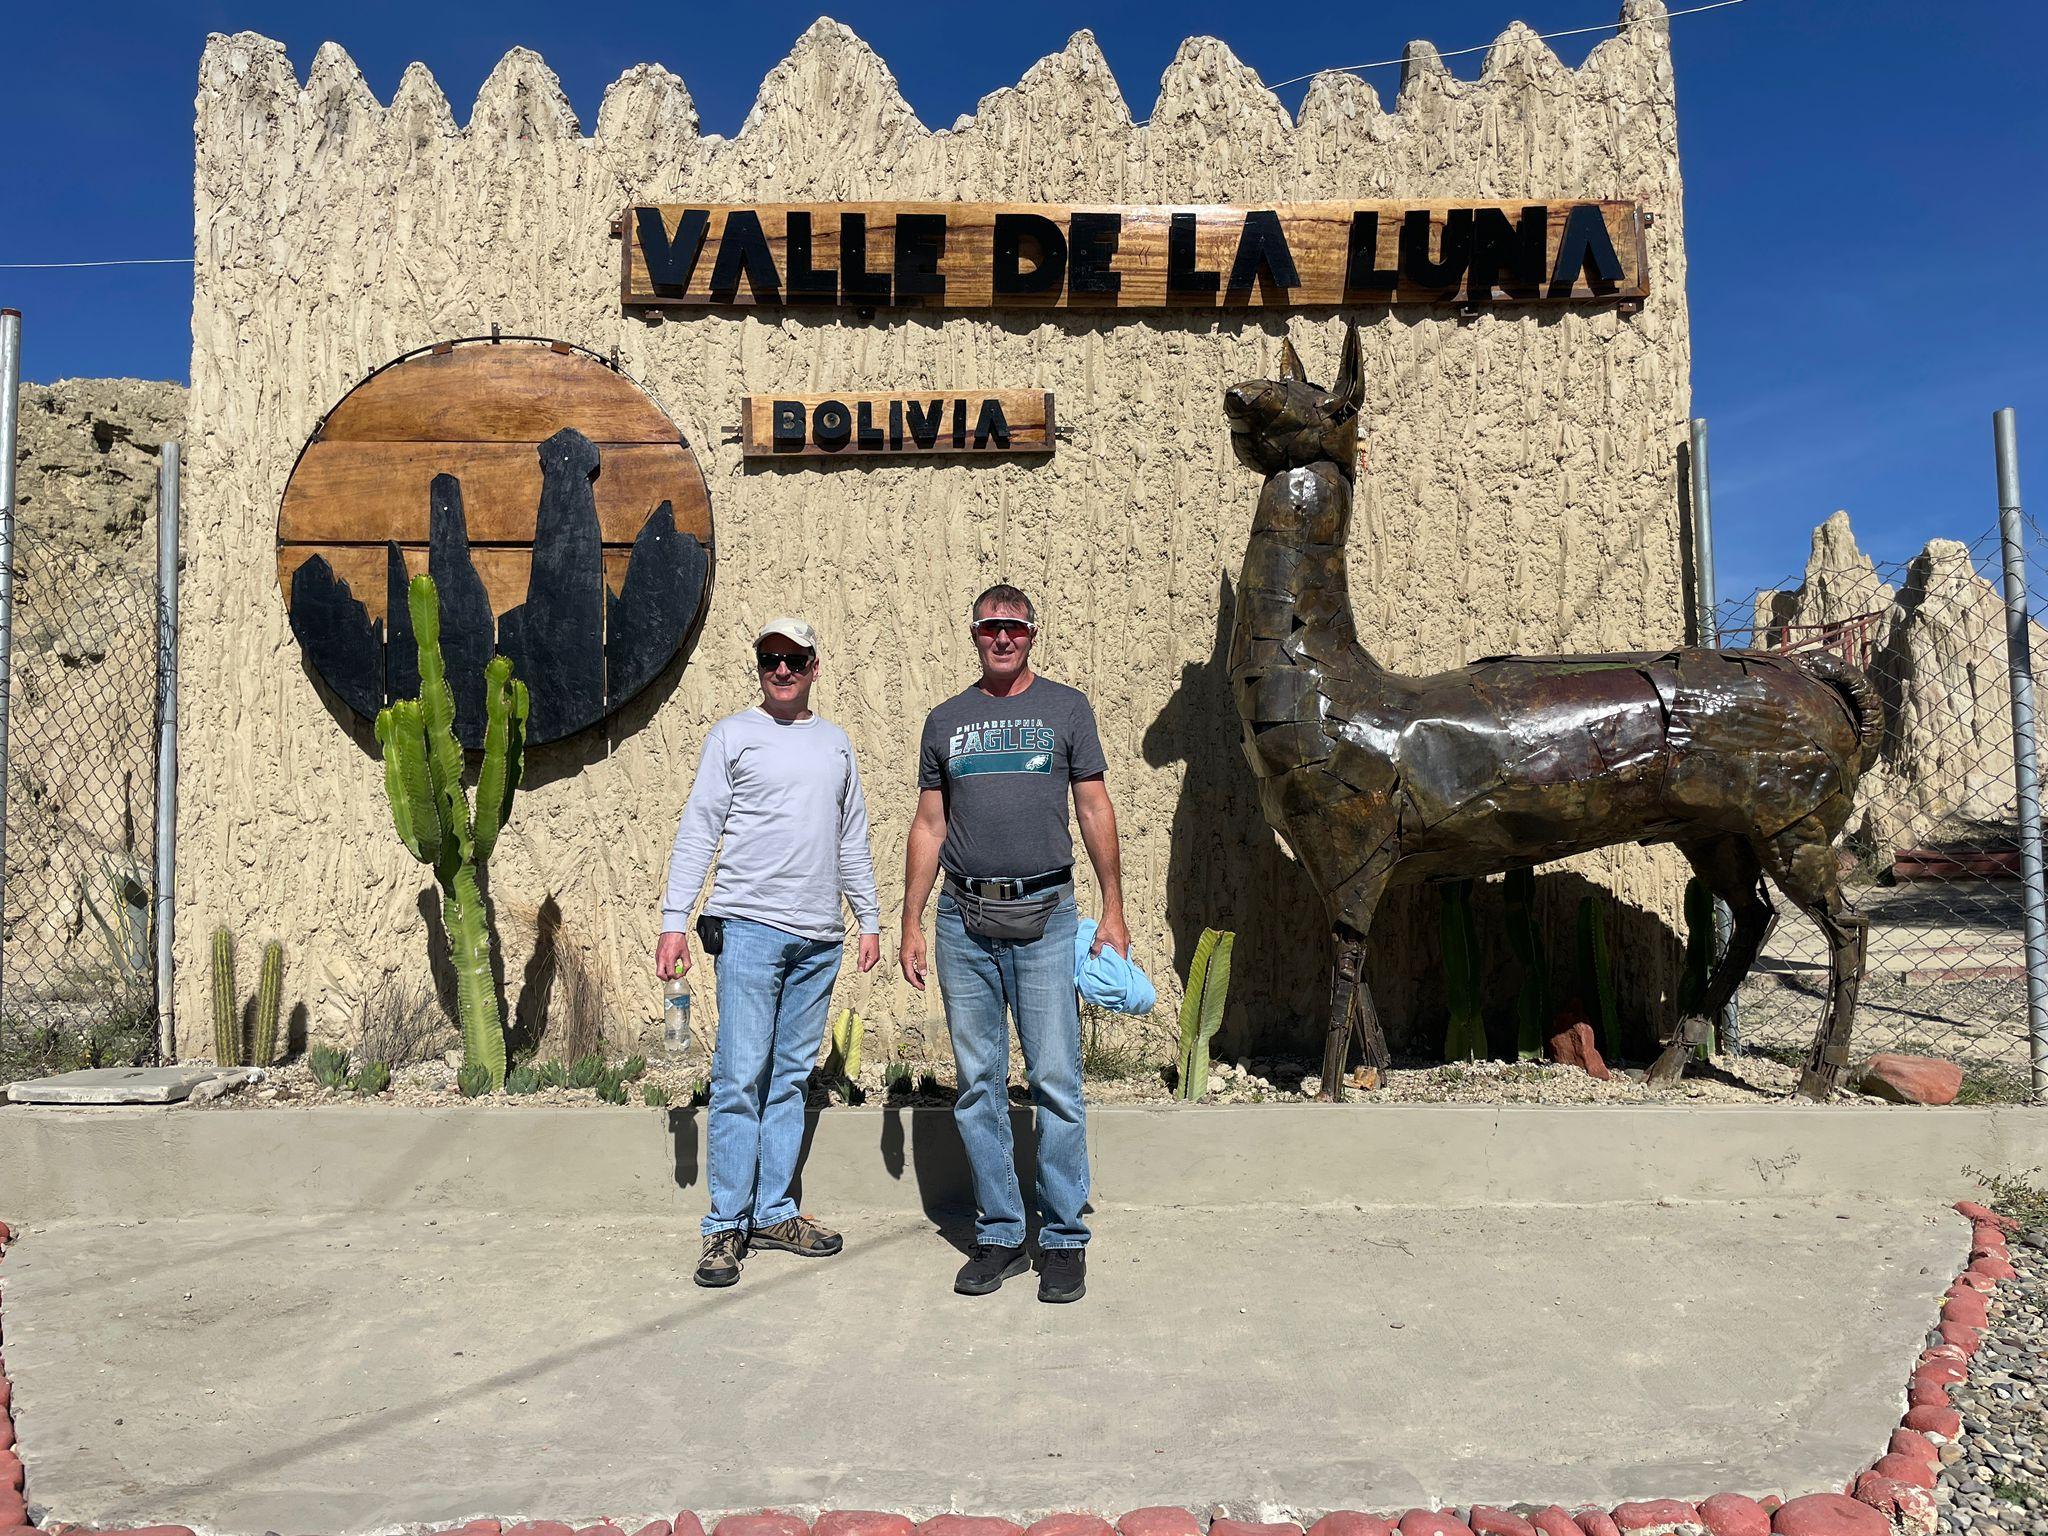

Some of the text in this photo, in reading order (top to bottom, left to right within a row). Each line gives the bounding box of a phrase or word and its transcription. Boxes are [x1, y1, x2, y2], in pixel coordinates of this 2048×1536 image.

[635, 205, 1625, 296] VALLE DE LA LUNA
[773, 399, 1011, 447] BOLIVIA
[949, 727, 1055, 757] EAGLES
[956, 718, 1044, 734] PHILADELPHIA
